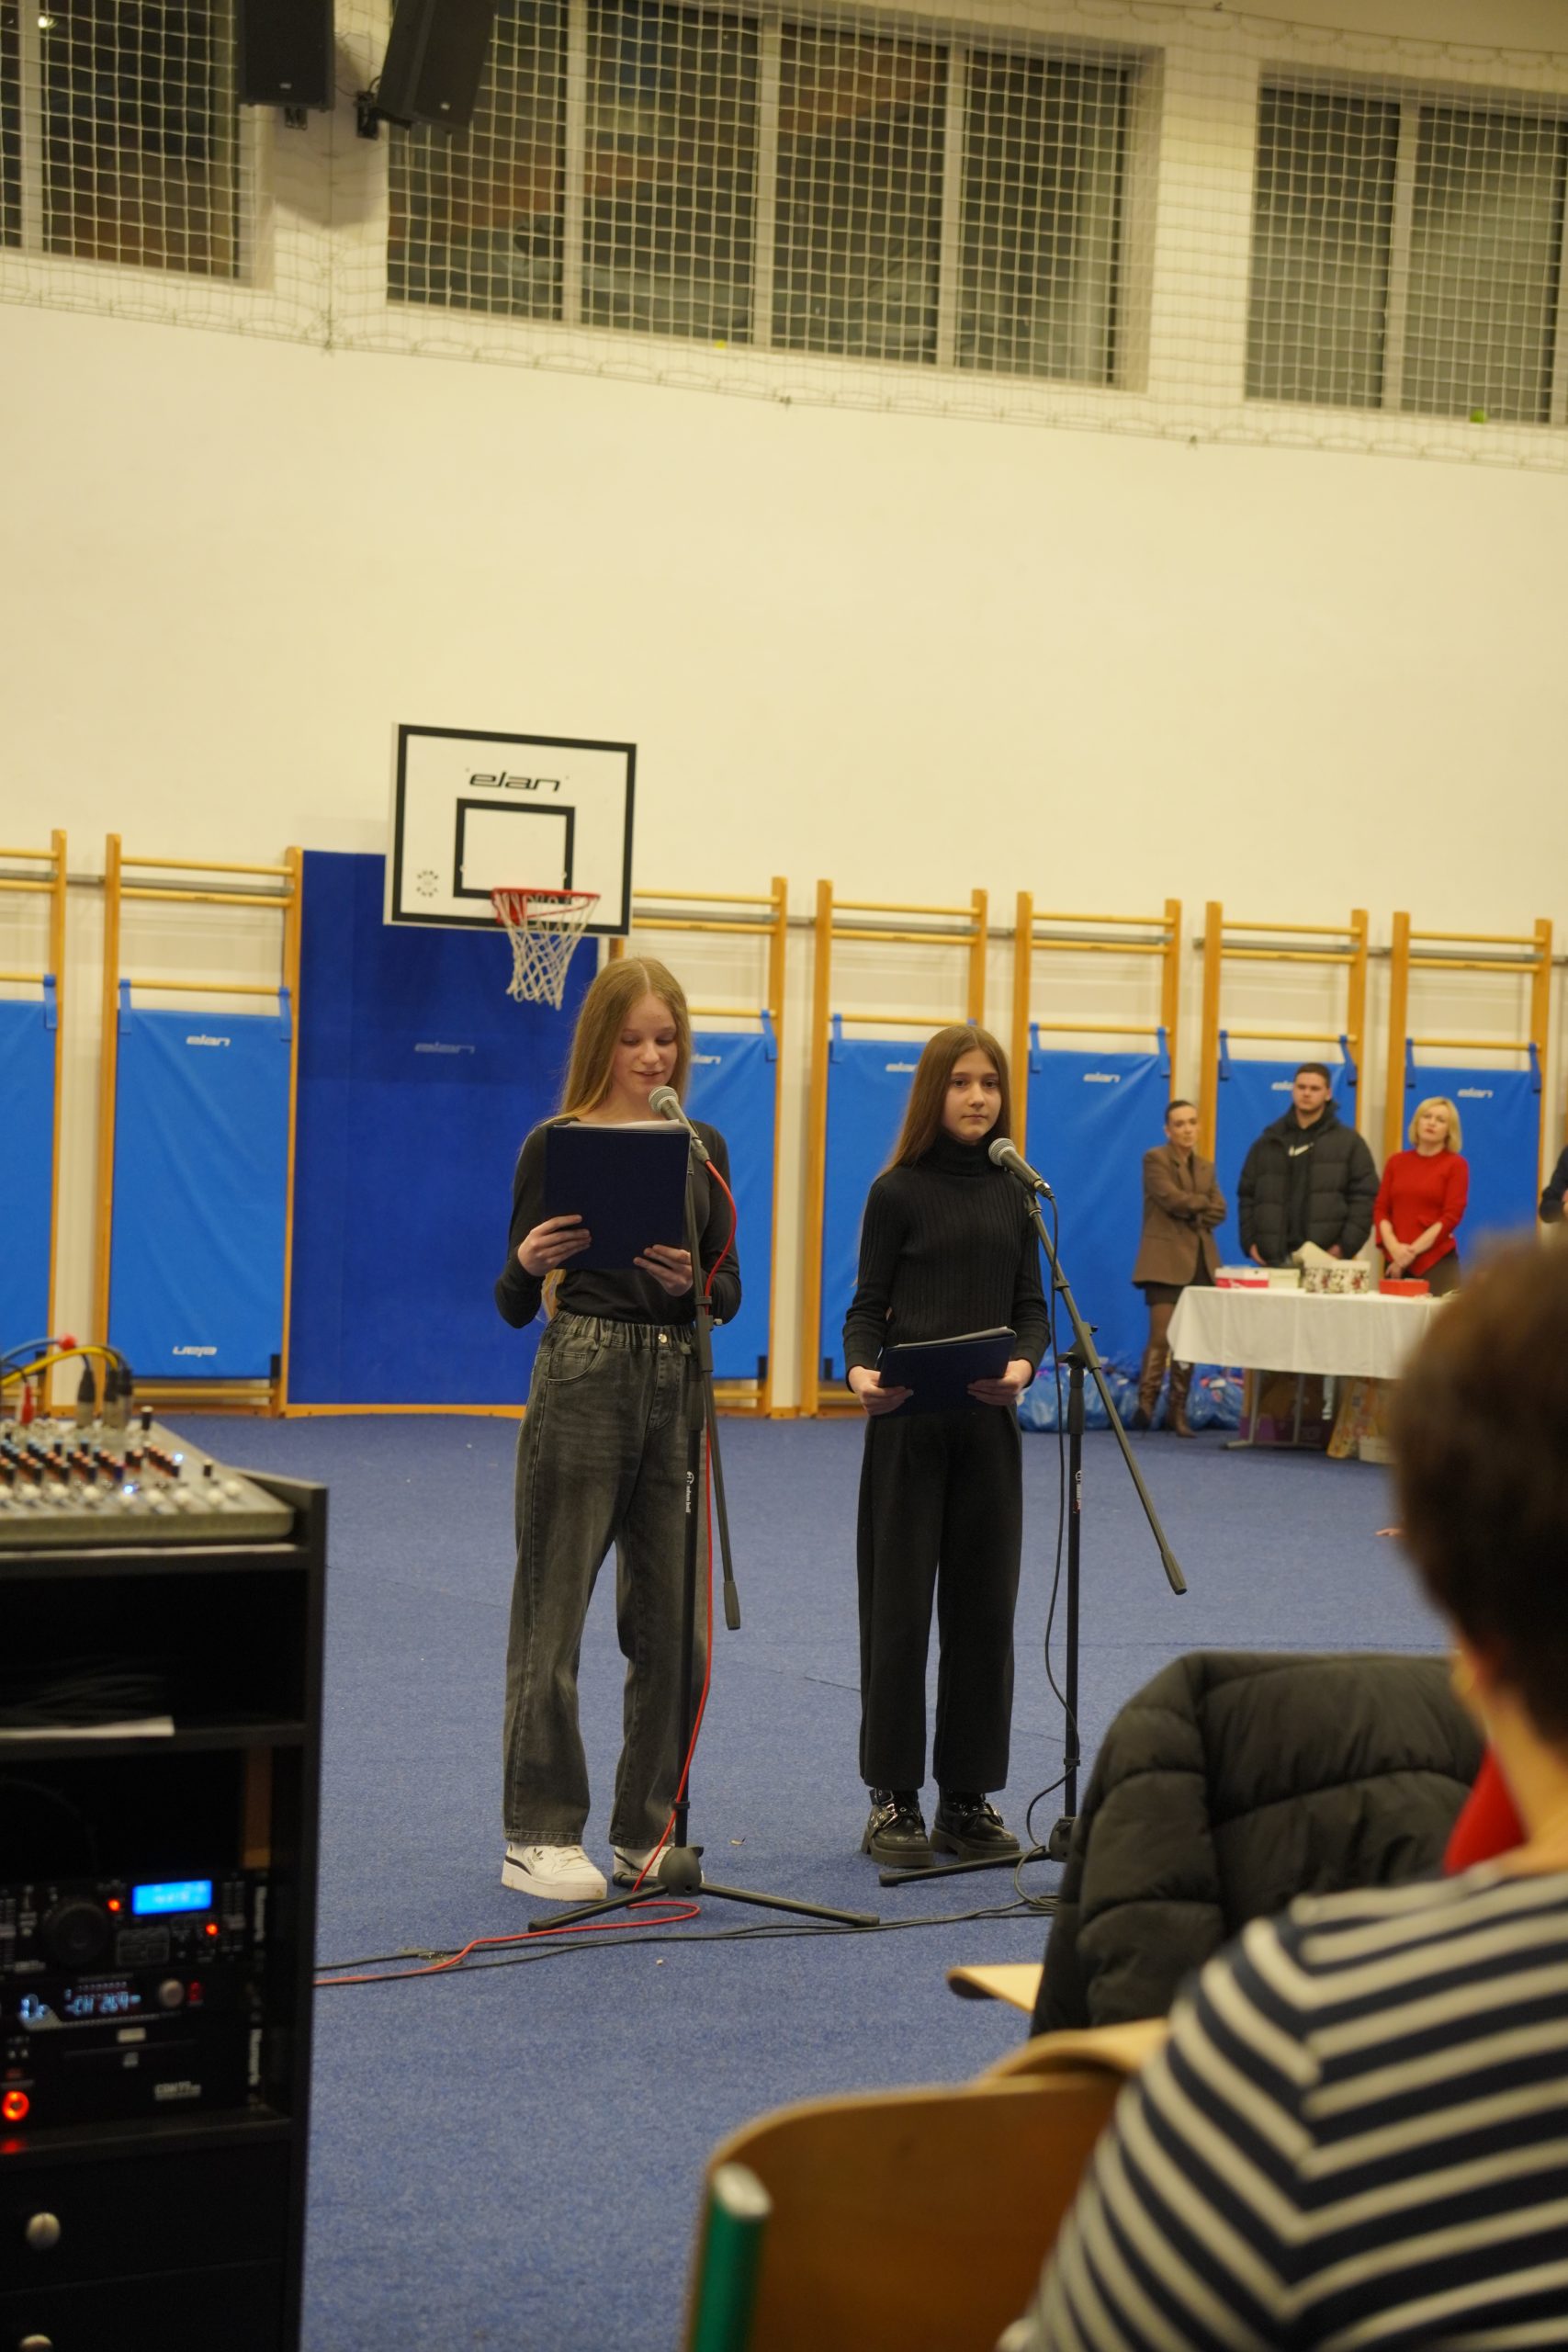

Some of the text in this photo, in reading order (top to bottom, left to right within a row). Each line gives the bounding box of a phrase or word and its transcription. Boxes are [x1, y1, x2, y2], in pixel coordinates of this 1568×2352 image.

[469, 771, 560, 793] elan
[186, 1035, 231, 1046] elan
[886, 1062, 918, 1073] ela
[1084, 1071, 1121, 1083] elan
[1458, 1087, 1493, 1099] elan
